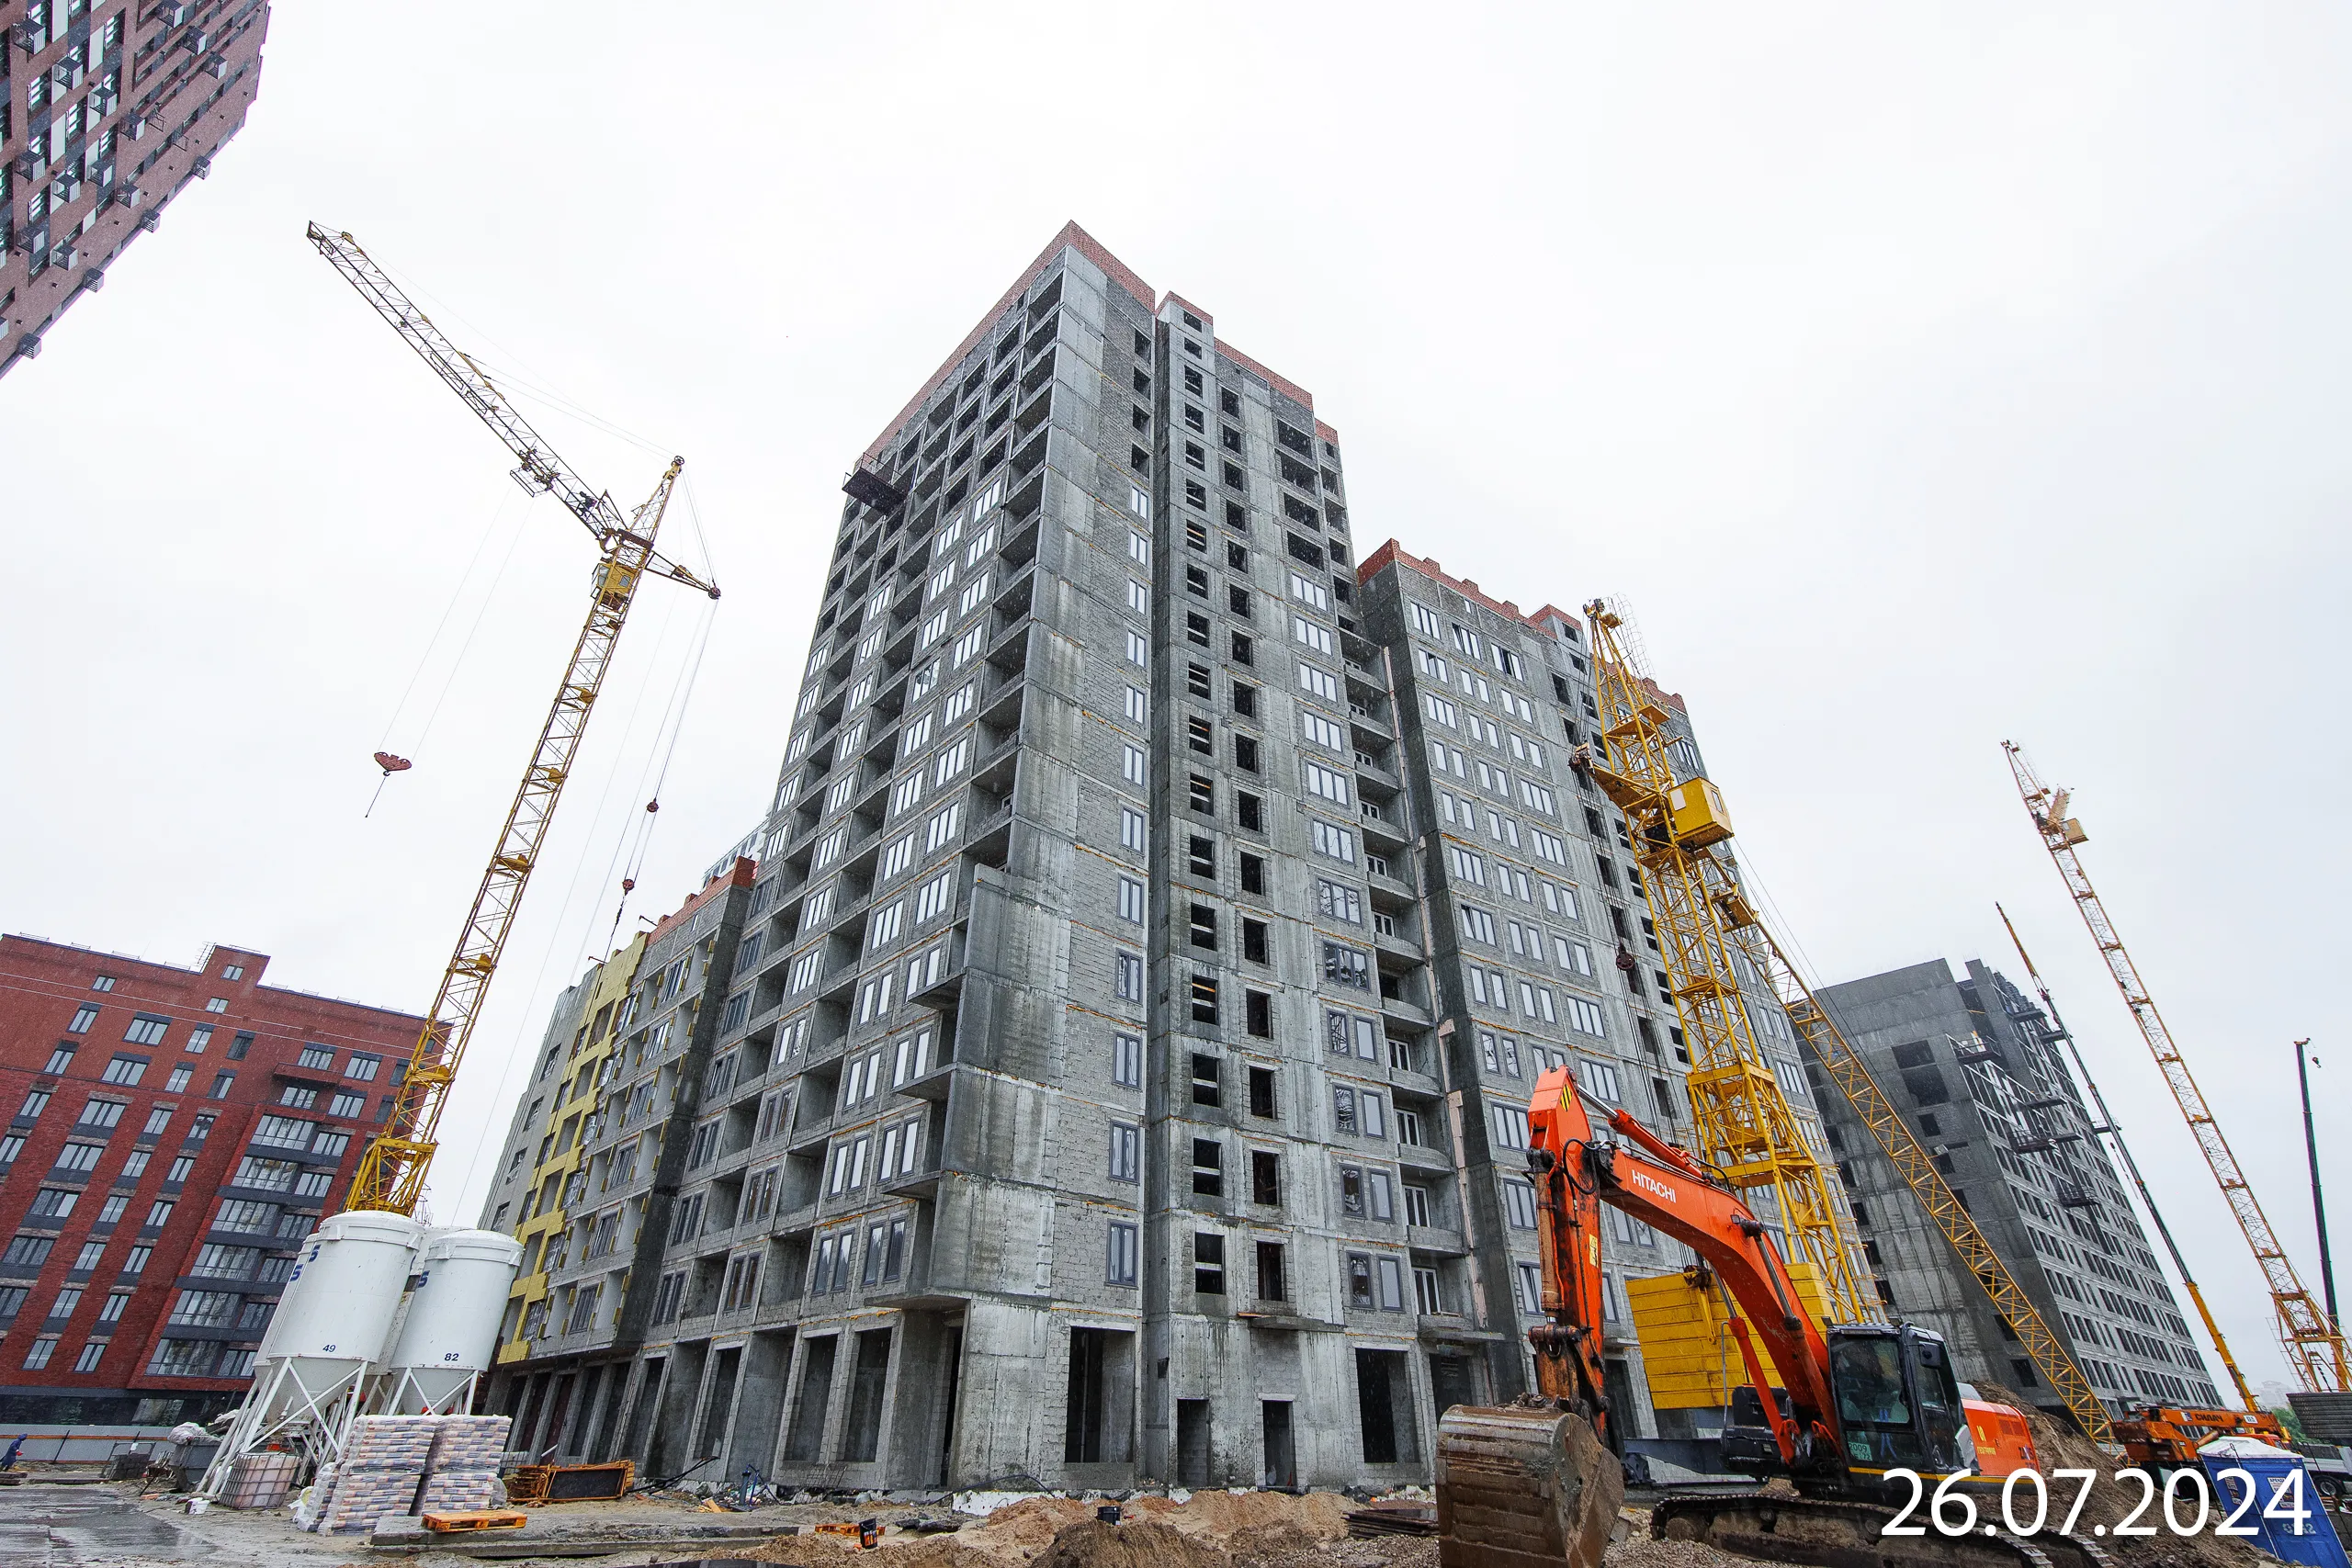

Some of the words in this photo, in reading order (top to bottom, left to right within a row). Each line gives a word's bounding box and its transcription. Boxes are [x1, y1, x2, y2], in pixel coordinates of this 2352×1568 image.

[1632, 1169, 1676, 1203] HITACHI
[322, 1344, 336, 1352] 49
[444, 1352, 459, 1361] 82
